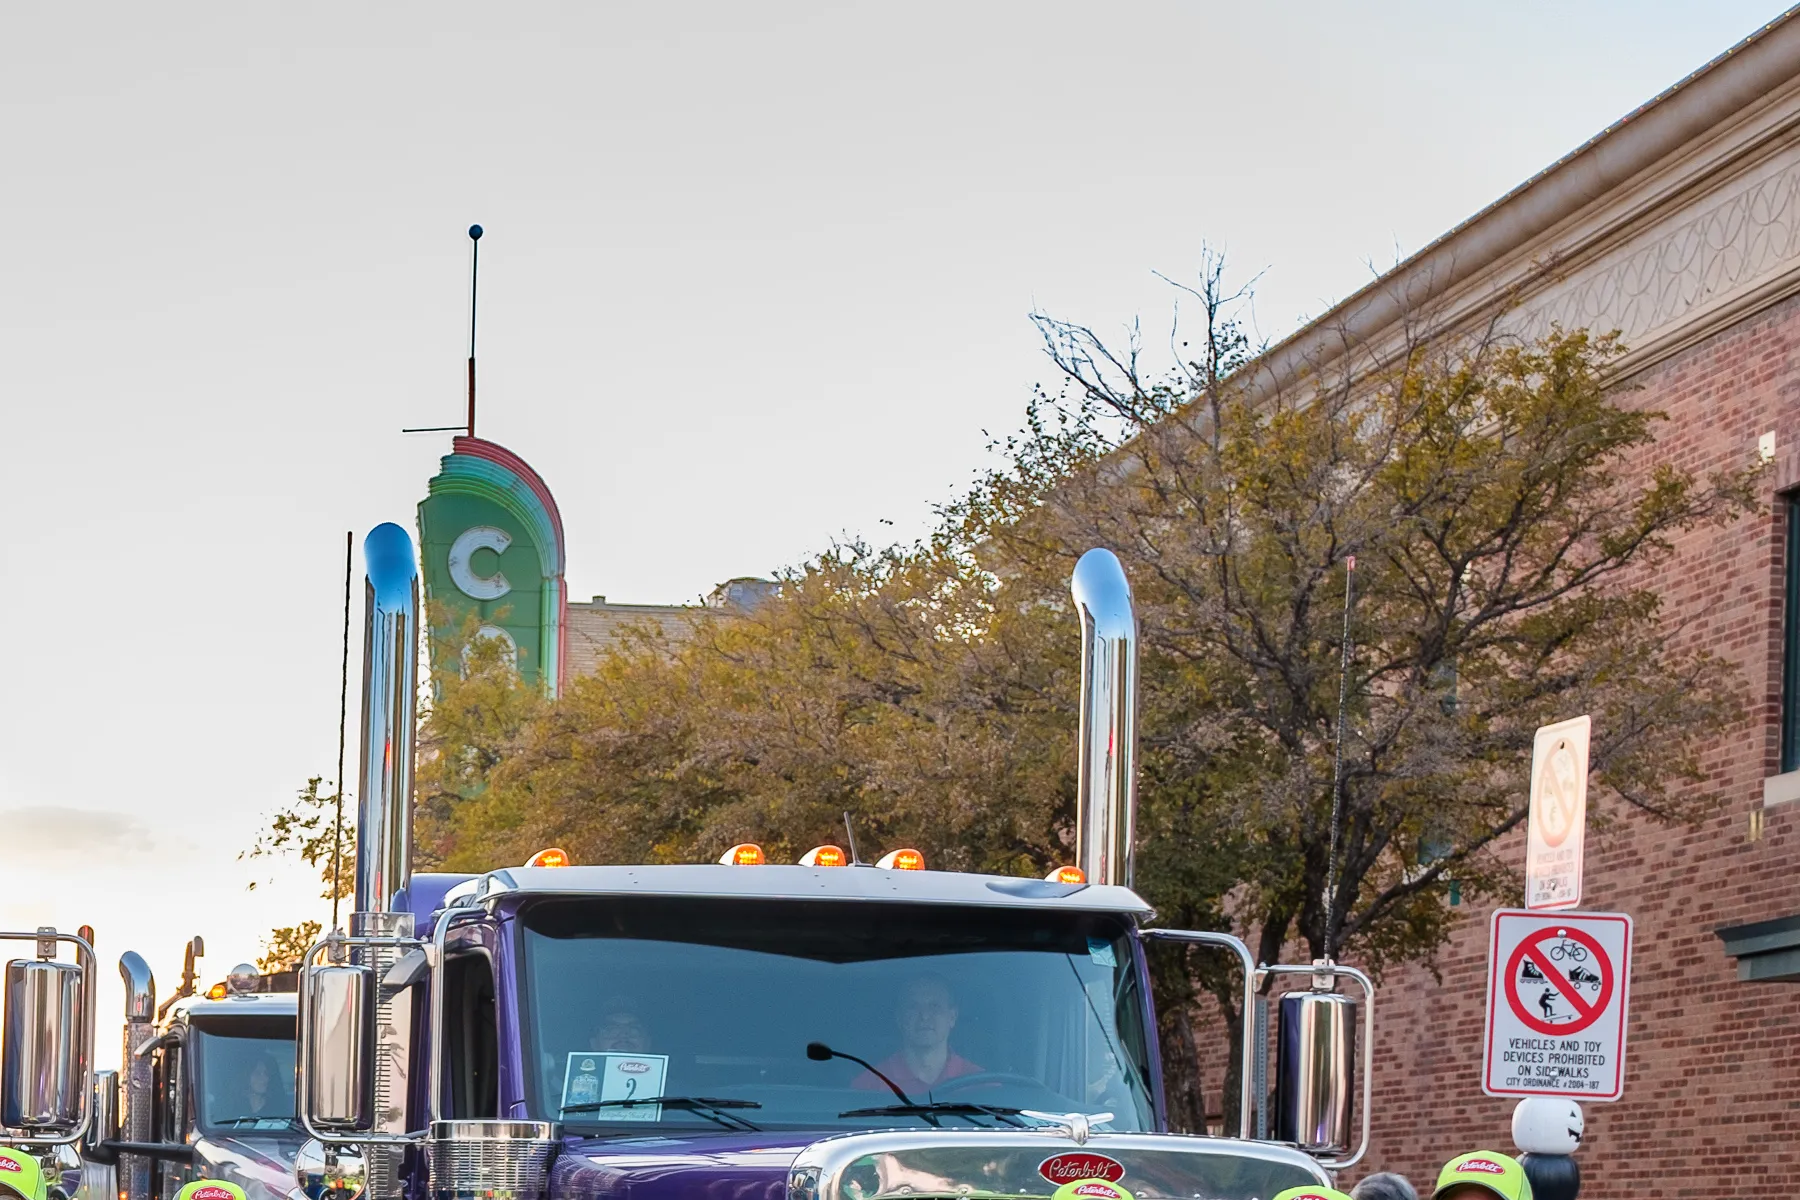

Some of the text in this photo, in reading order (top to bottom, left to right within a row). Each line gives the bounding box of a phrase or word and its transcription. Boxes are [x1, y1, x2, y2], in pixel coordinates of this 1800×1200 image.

[1509, 1038, 1601, 1052] VEHICLES AND TOY
[1503, 1051, 1605, 1066] DEVICES PROHIBITED
[1518, 1065, 1589, 1078] ON SIDEWALKS
[1506, 1077, 1520, 1087] CITY
[1523, 1078, 1560, 1088] ORDINANCE
[1568, 1080, 1600, 1089] 2004-187
[1049, 1158, 1117, 1179] Peterbilt
[1461, 1161, 1503, 1173] Peterbilt
[194, 1188, 232, 1200] Peterbilt
[1078, 1185, 1116, 1197] Peterbilt
